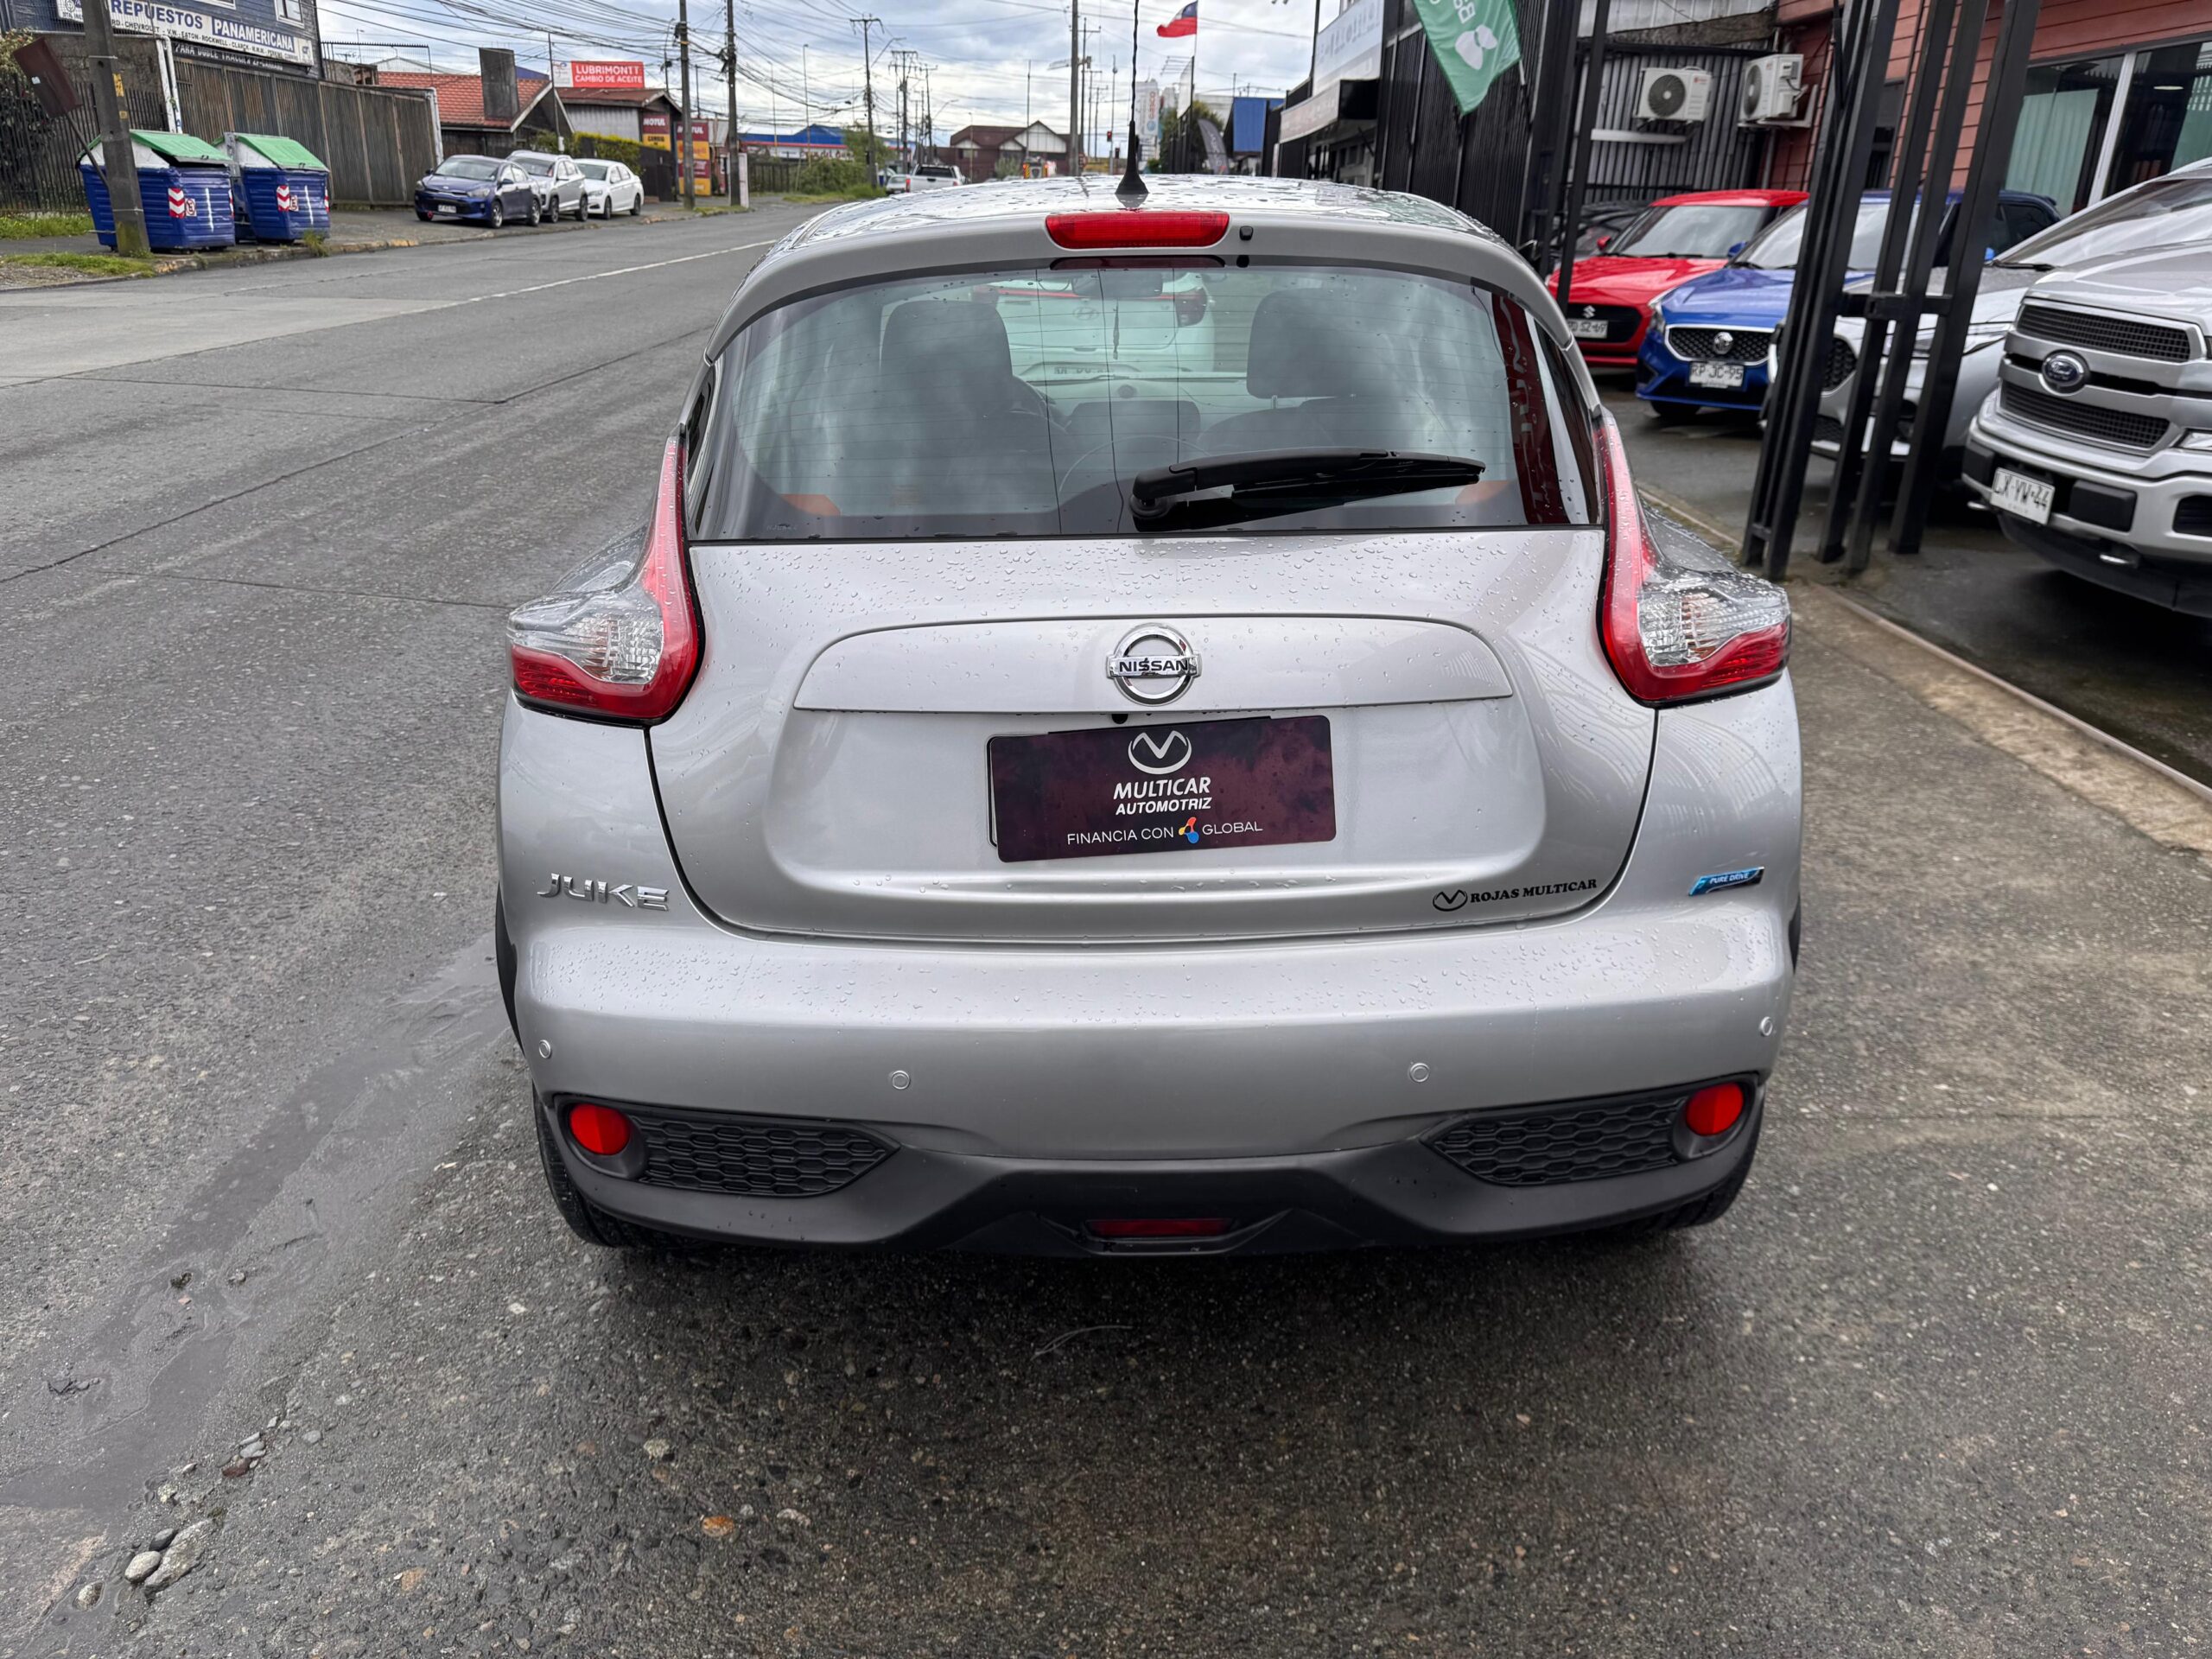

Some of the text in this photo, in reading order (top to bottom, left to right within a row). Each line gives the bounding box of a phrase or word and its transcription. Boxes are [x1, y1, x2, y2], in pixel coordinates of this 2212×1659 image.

[111, 0, 295, 51] REPUESTOS PANAMERICANA
[124, 21, 160, 33] CHEVROLET
[181, 31, 199, 40] EATON
[202, 35, 228, 46] ROCKWELL
[575, 65, 639, 75] LUBRIMONTT
[643, 118, 665, 126] MOTUL
[1118, 658, 1189, 672] NISSAN
[1113, 777, 1211, 801] MULTICAR
[1115, 797, 1211, 817] AUTOMOTRIZ
[1066, 820, 1263, 846] FINANCIA CON GLOBAL
[1709, 872, 1750, 884] PURE DRIVE
[536, 872, 670, 912] JUKE
[1470, 879, 1598, 905] ROJAS MULTICAR
